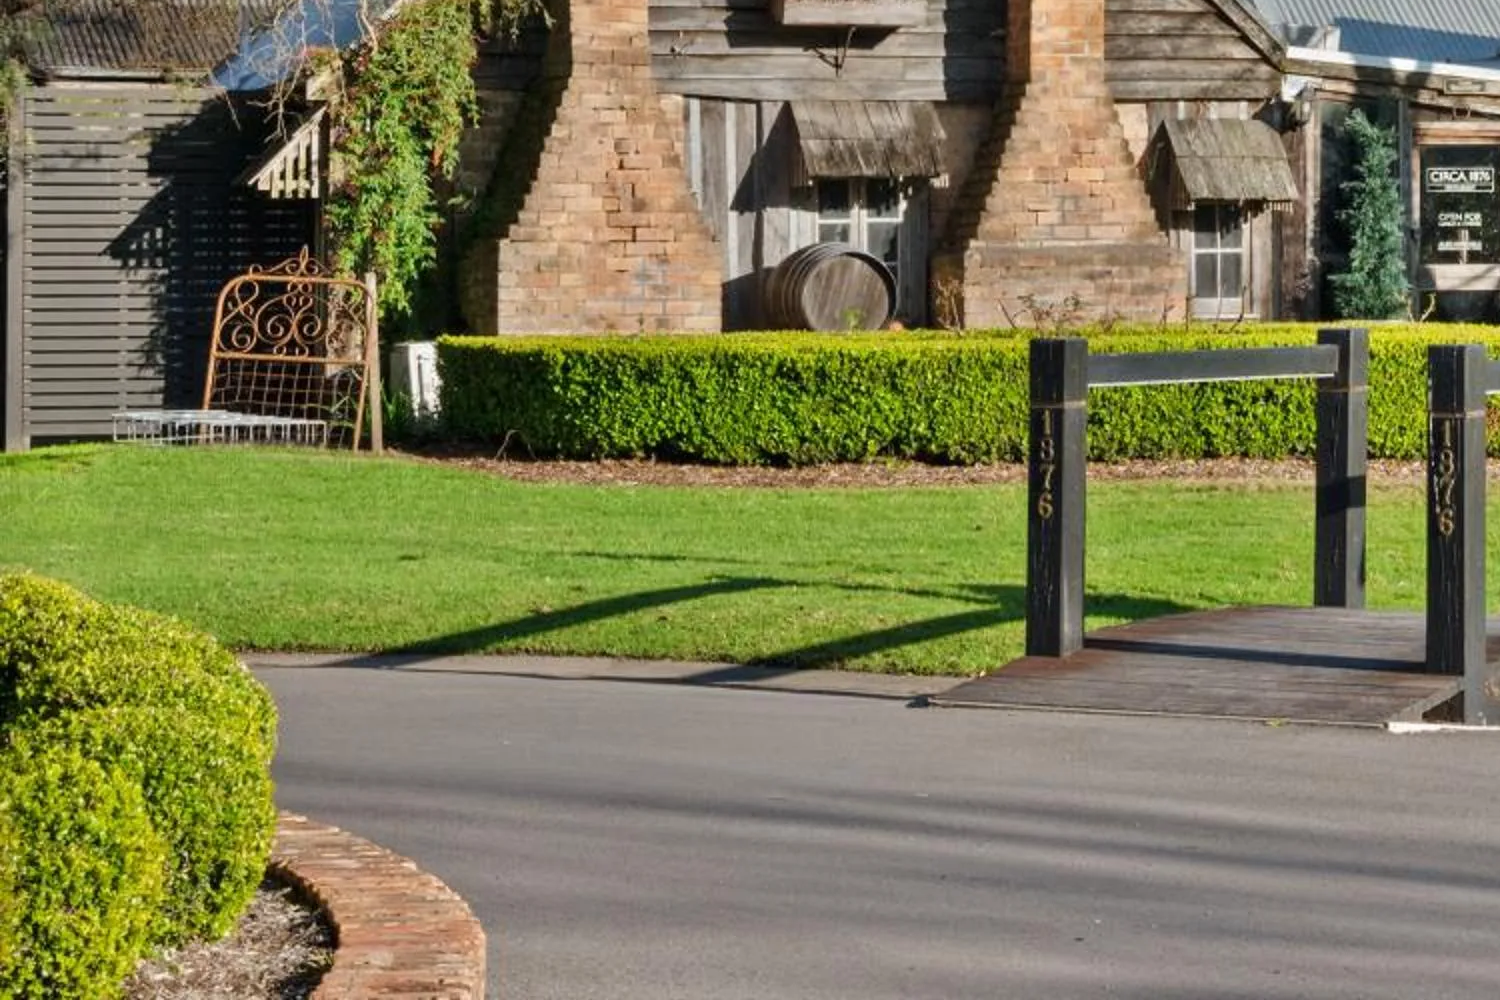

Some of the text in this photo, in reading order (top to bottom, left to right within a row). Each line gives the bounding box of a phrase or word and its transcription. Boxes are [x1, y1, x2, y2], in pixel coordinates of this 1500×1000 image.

[1430, 171, 1468, 182] CIRCA
[1037, 408, 1055, 519] 1876
[1439, 419, 1455, 536] 1876
